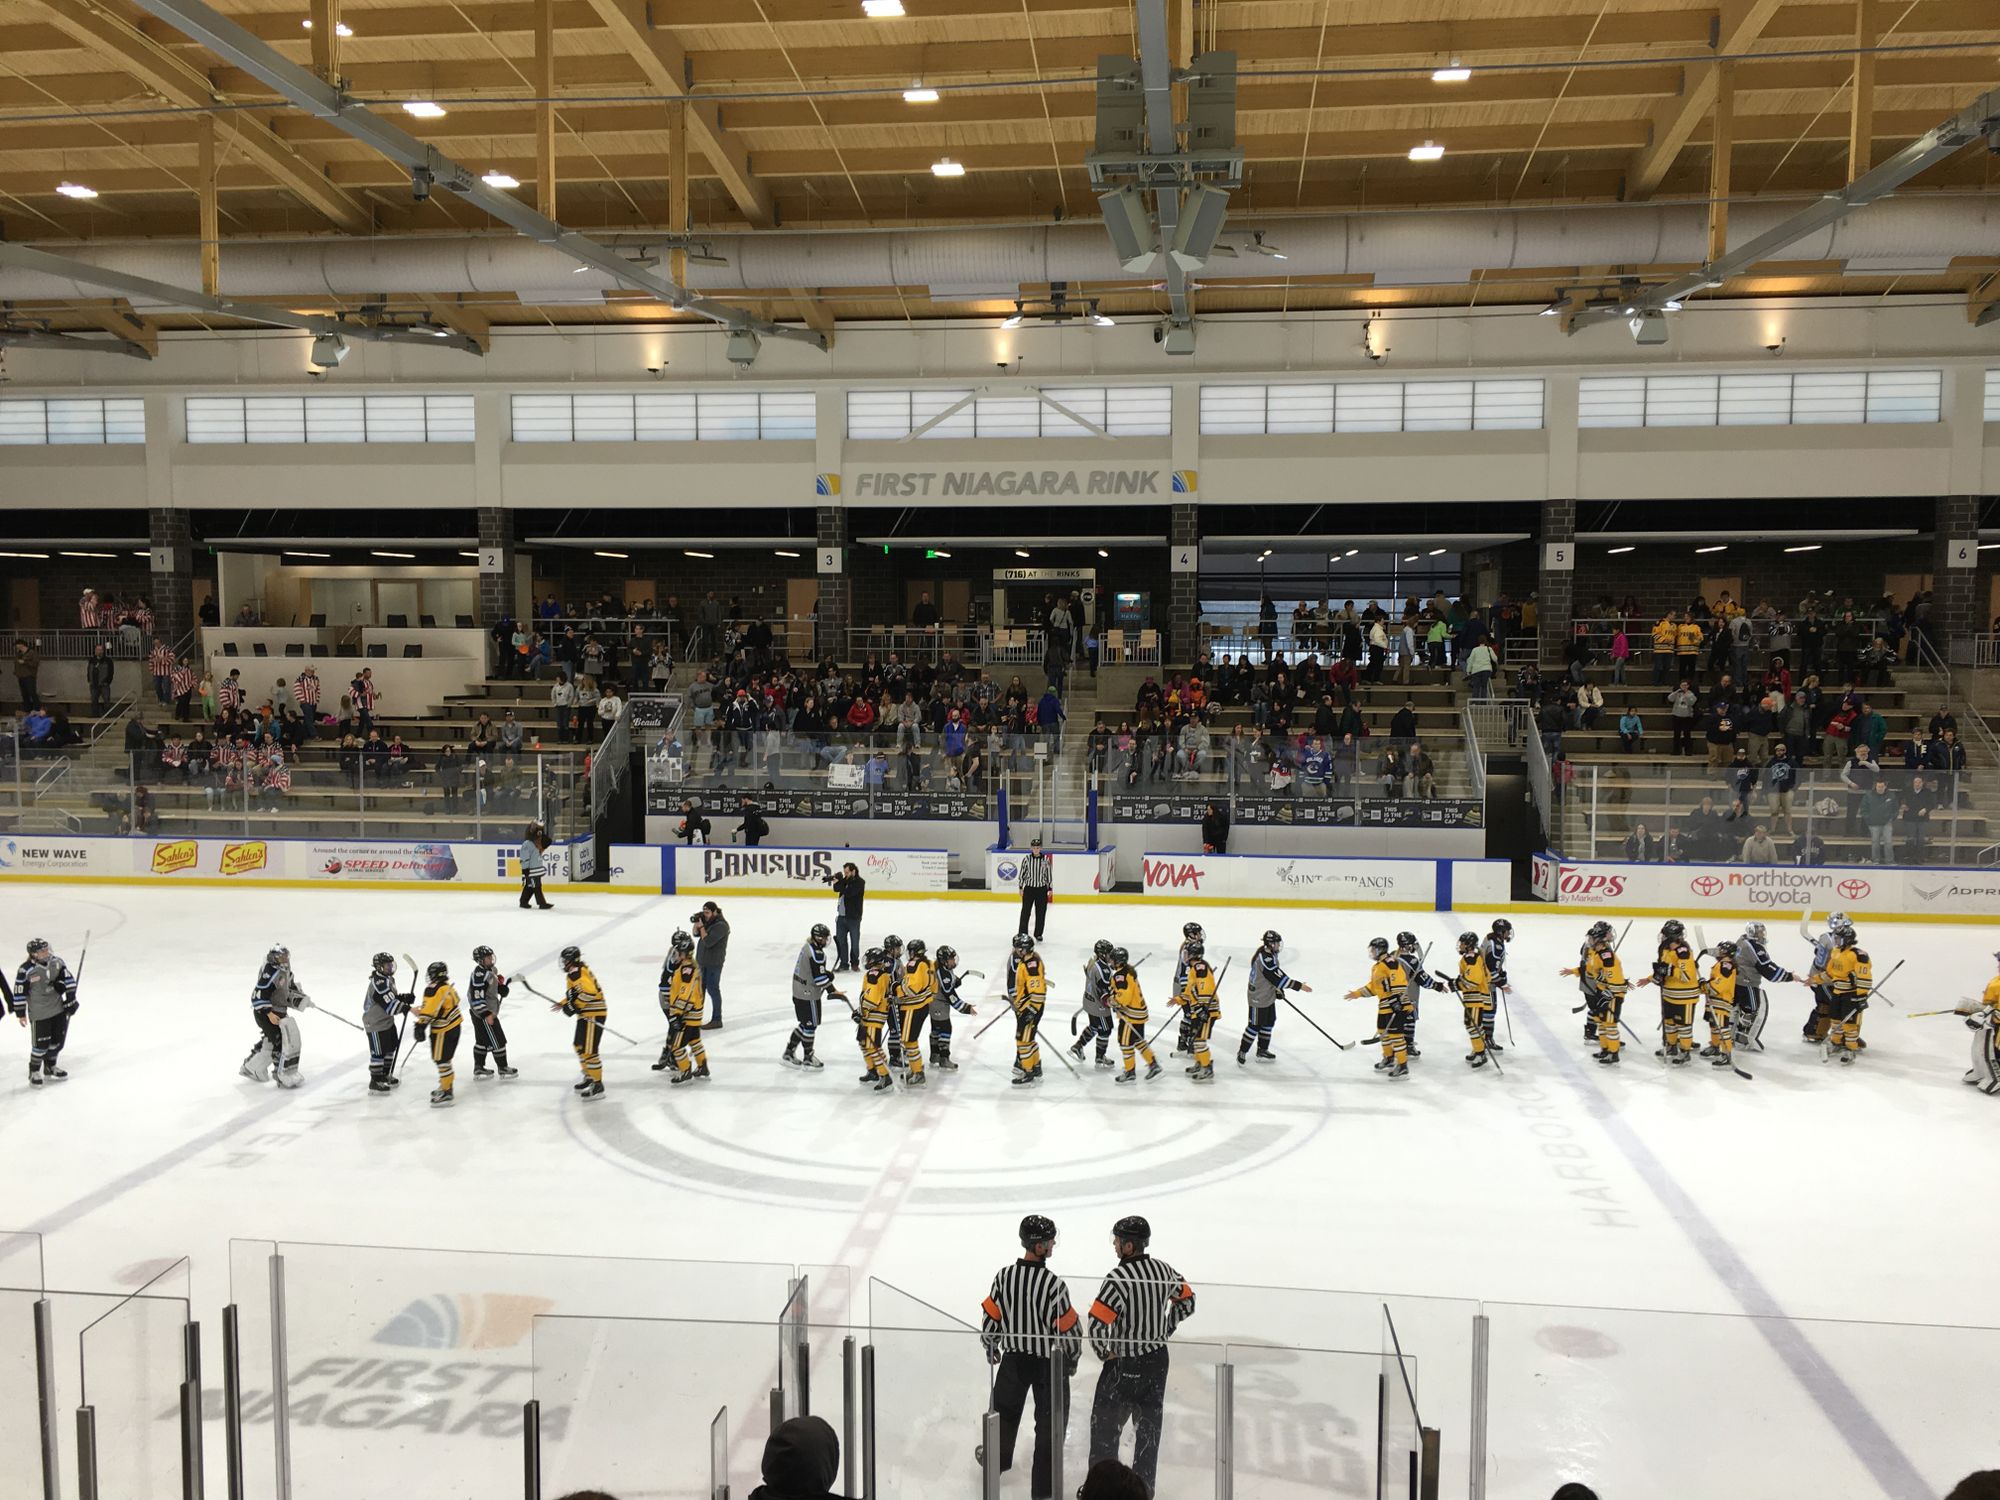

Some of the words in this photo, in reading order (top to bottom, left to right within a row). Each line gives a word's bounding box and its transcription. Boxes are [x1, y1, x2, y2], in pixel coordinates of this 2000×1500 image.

[856, 473, 937, 496] FIRST
[942, 471, 1080, 496] NIAGARA
[1087, 470, 1159, 495] RINK
[159, 554, 164, 565] 1
[1180, 553, 1188, 565] 4
[1556, 551, 1564, 563] 5
[1959, 548, 1967, 560] 6
[488, 555, 495, 566] 2
[826, 555, 833, 566] 3
[1005, 570, 1026, 579] (716)
[633, 717, 662, 727] Beauts
[22, 848, 49, 859] NEW
[53, 849, 87, 859] WAVE
[156, 844, 195, 867] Sahlen's
[224, 846, 264, 867] Sahlen's
[22, 860, 47, 868] Energy
[48, 860, 88, 868] Corporation
[344, 859, 390, 869] SPEED
[866, 854, 889, 868] Chef's
[704, 850, 832, 886] CANISIUS
[1143, 859, 1205, 891] NOVA
[1728, 869, 1833, 890] northtown
[1749, 888, 1812, 908] toyota
[1947, 886, 2000, 898] ADPR
[1571, 894, 1604, 903] Markets
[288, 1356, 542, 1395] FIRST
[154, 1388, 573, 1442] NIAGARA
